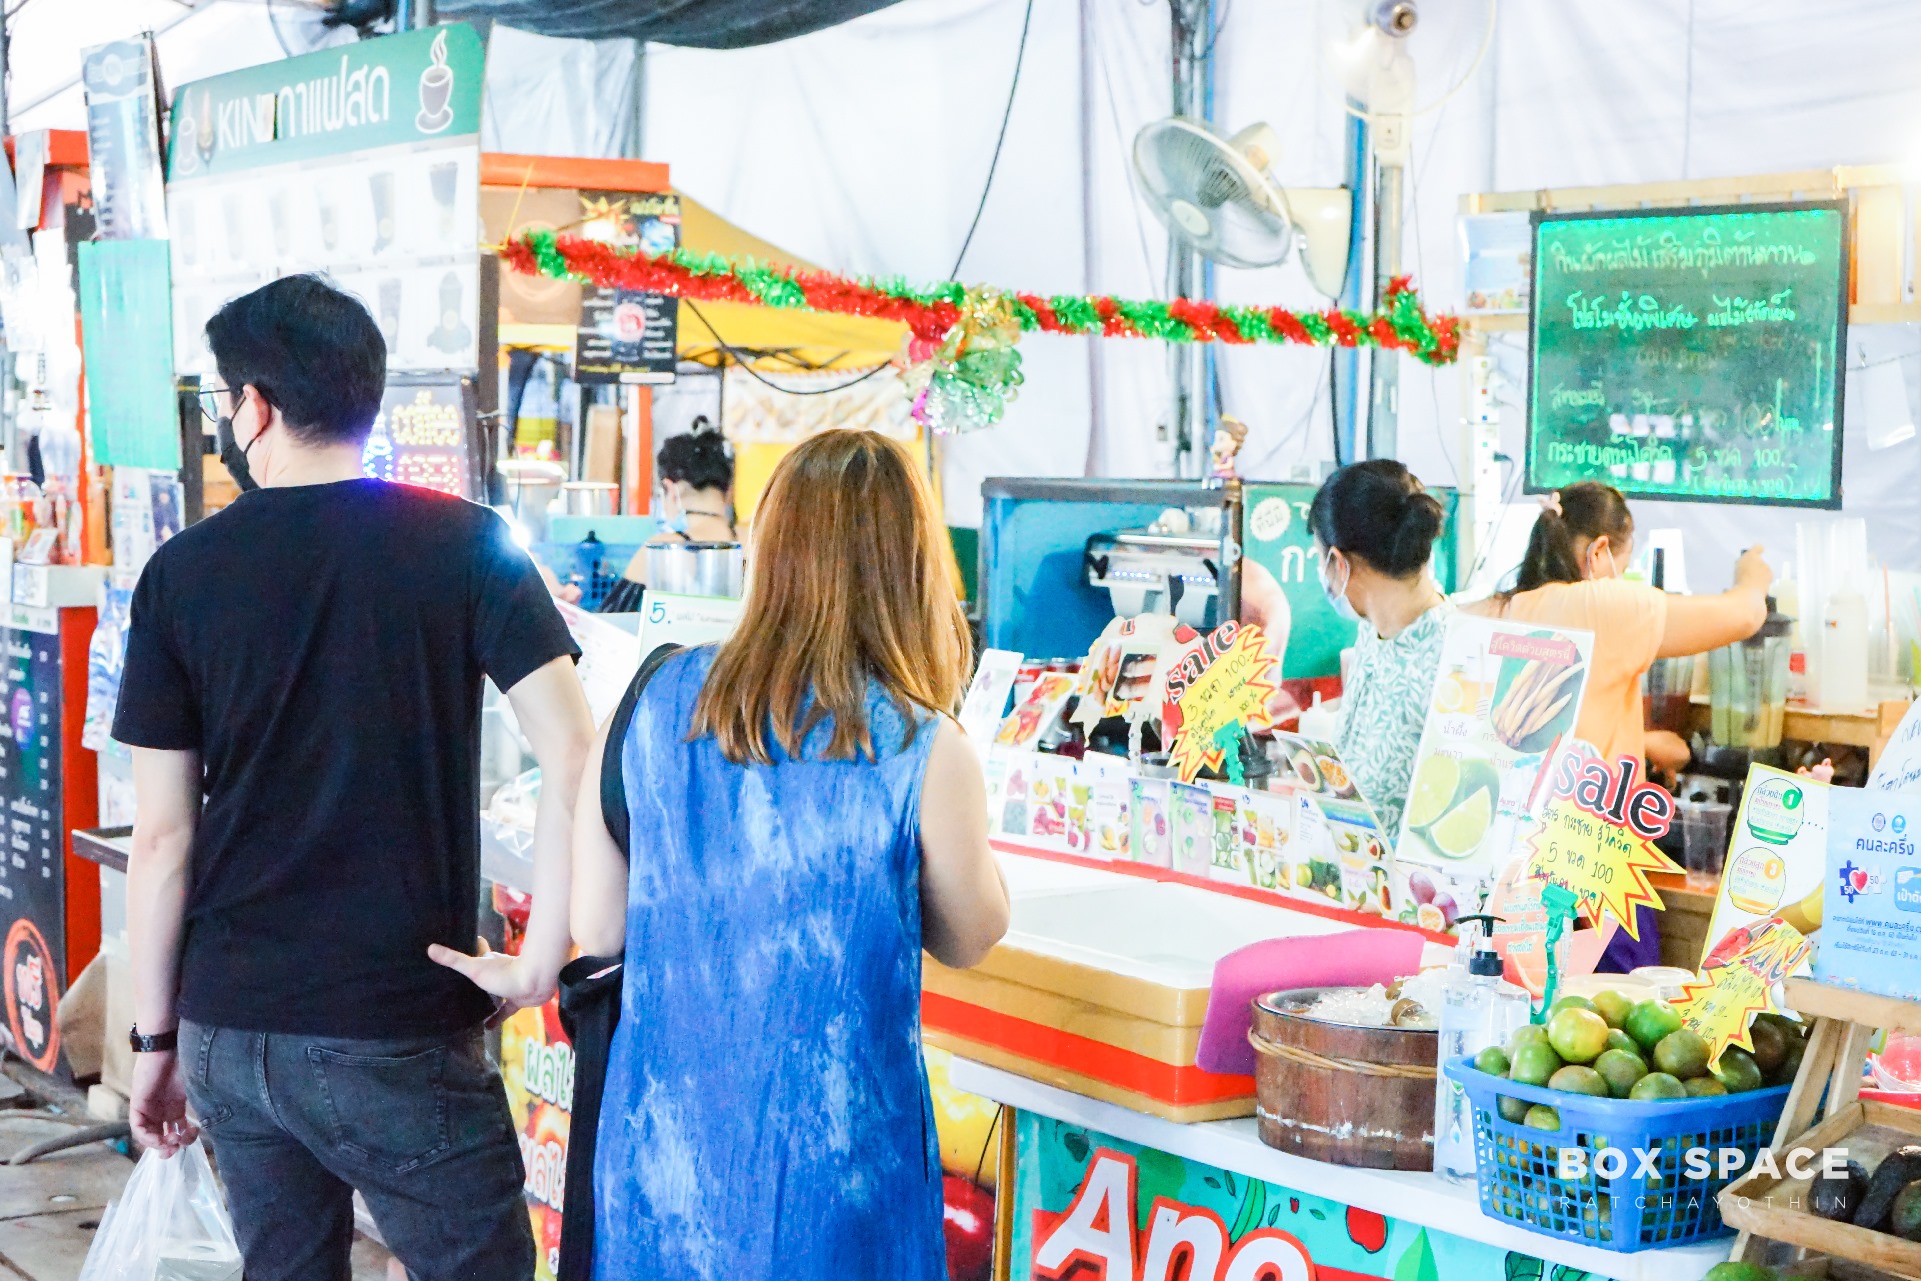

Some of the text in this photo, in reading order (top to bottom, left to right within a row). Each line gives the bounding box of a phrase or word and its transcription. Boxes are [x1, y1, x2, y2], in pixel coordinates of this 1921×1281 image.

[277, 54, 390, 139] กาแฟสด
[1166, 620, 1240, 704] sale
[1553, 751, 1671, 836] sale
[1787, 792, 1795, 806] 1
[1856, 834, 1915, 857] คนละครึ่ง
[1547, 842, 1558, 863] 5
[1591, 861, 1614, 884] 100
[1868, 874, 1880, 885] 50
[1897, 887, 1921, 904] เป๋าตั
